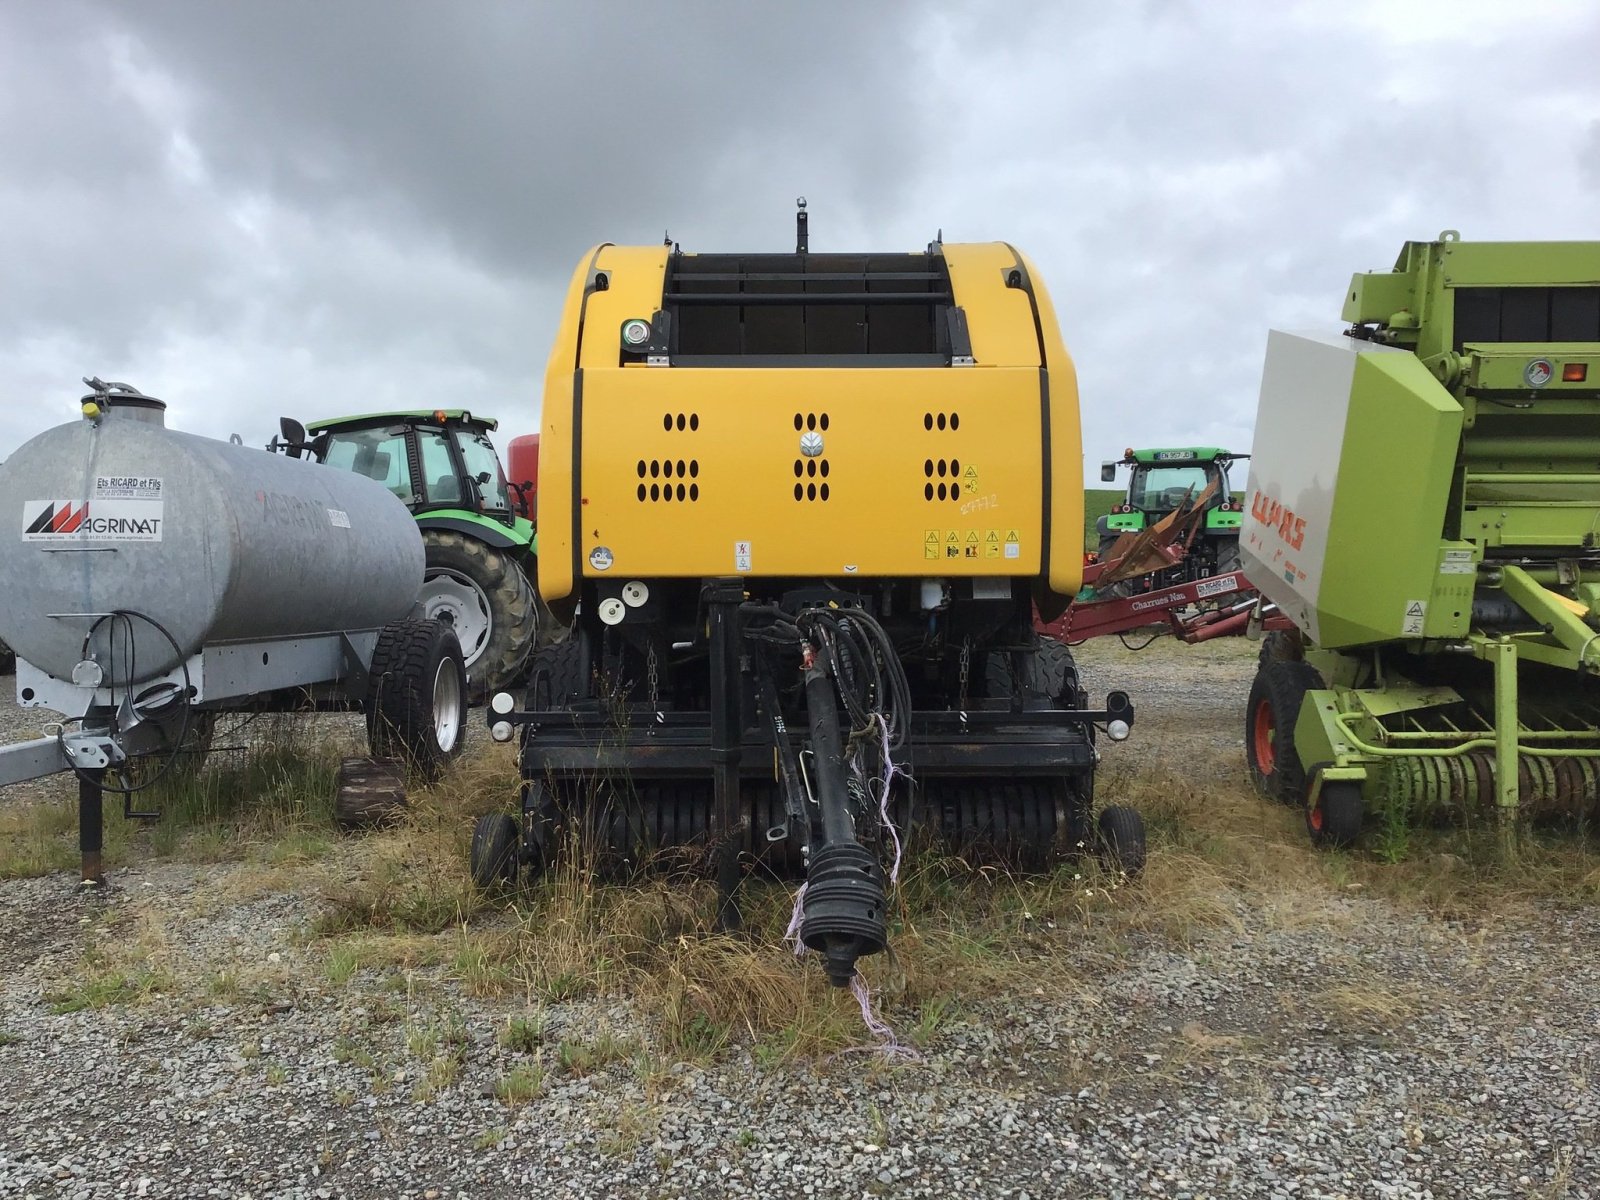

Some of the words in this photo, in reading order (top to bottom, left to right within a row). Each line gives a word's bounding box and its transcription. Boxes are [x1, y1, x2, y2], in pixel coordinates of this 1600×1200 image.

[96, 478, 109, 487] Ets
[110, 478, 138, 488] RICARD
[140, 479, 147, 488] et
[148, 478, 161, 488] Fils
[76, 518, 160, 534] AGRIMAT
